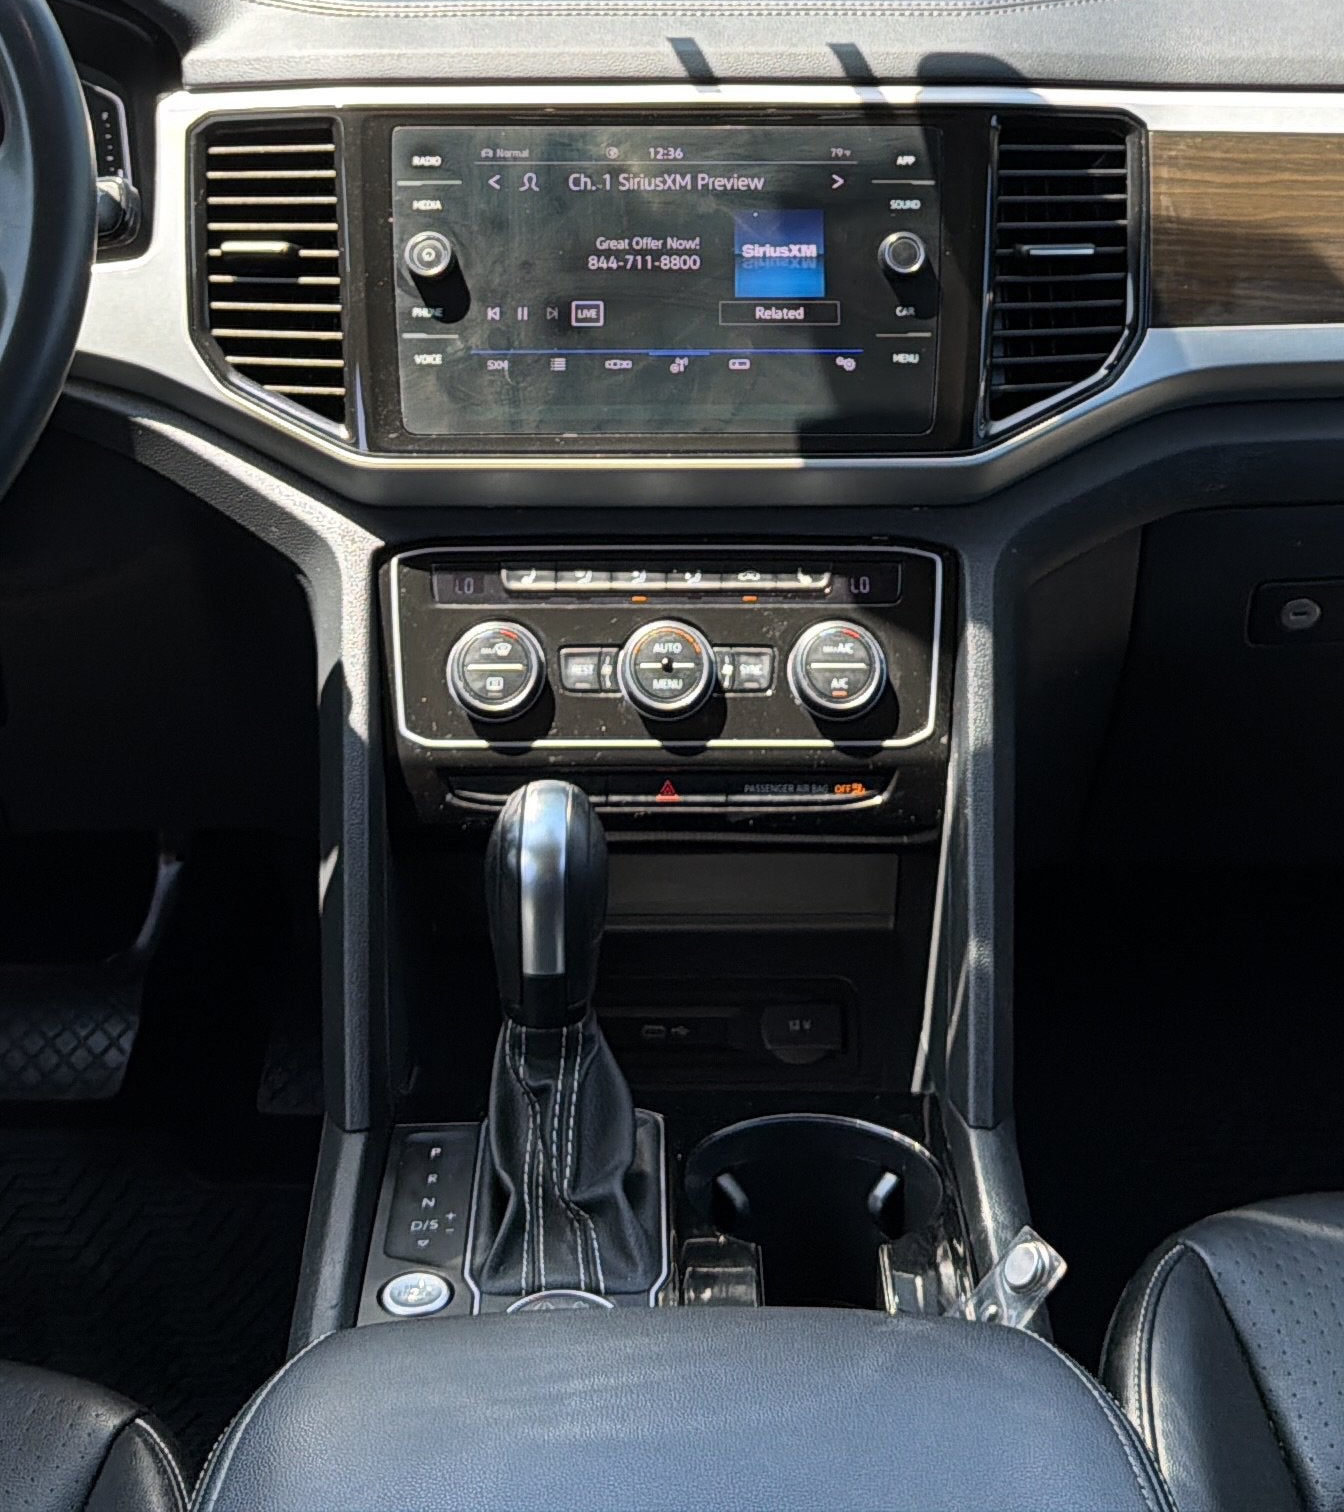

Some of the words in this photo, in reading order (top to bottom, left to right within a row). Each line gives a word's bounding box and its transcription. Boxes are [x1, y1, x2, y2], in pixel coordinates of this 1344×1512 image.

[496, 148, 529, 158] Normal
[648, 147, 684, 159] 12:36
[412, 155, 442, 167] RADIO
[896, 155, 916, 166] APP
[568, 173, 597, 191] Ch.
[603, 173, 611, 190] 1
[618, 173, 692, 191] SiriusXM
[698, 173, 764, 191] Preview
[412, 199, 443, 211] MEDIA
[889, 199, 921, 210] SOUND
[595, 237, 629, 250] Great
[632, 237, 663, 250] Offer
[666, 237, 700, 250] Now!
[741, 244, 817, 258] SiriusXM
[587, 255, 700, 270] 844-711-8800
[577, 308, 598, 319] LIVE
[755, 306, 805, 320] Related
[895, 306, 915, 317] CAR
[413, 354, 443, 365] VOICE
[893, 353, 920, 364] MENU
[456, 577, 474, 594] LO
[850, 576, 870, 594] LO
[653, 642, 682, 654] AUTO
[571, 664, 595, 675] REST
[652, 678, 683, 690] MENU
[831, 677, 849, 689] A/C
[744, 784, 794, 793] PASSENGER
[796, 784, 810, 793] AIR
[834, 784, 851, 793] OFF
[430, 1147, 442, 1160] P
[427, 1173, 437, 1184] R
[421, 1197, 436, 1209] N
[410, 1219, 439, 1231] D/S
